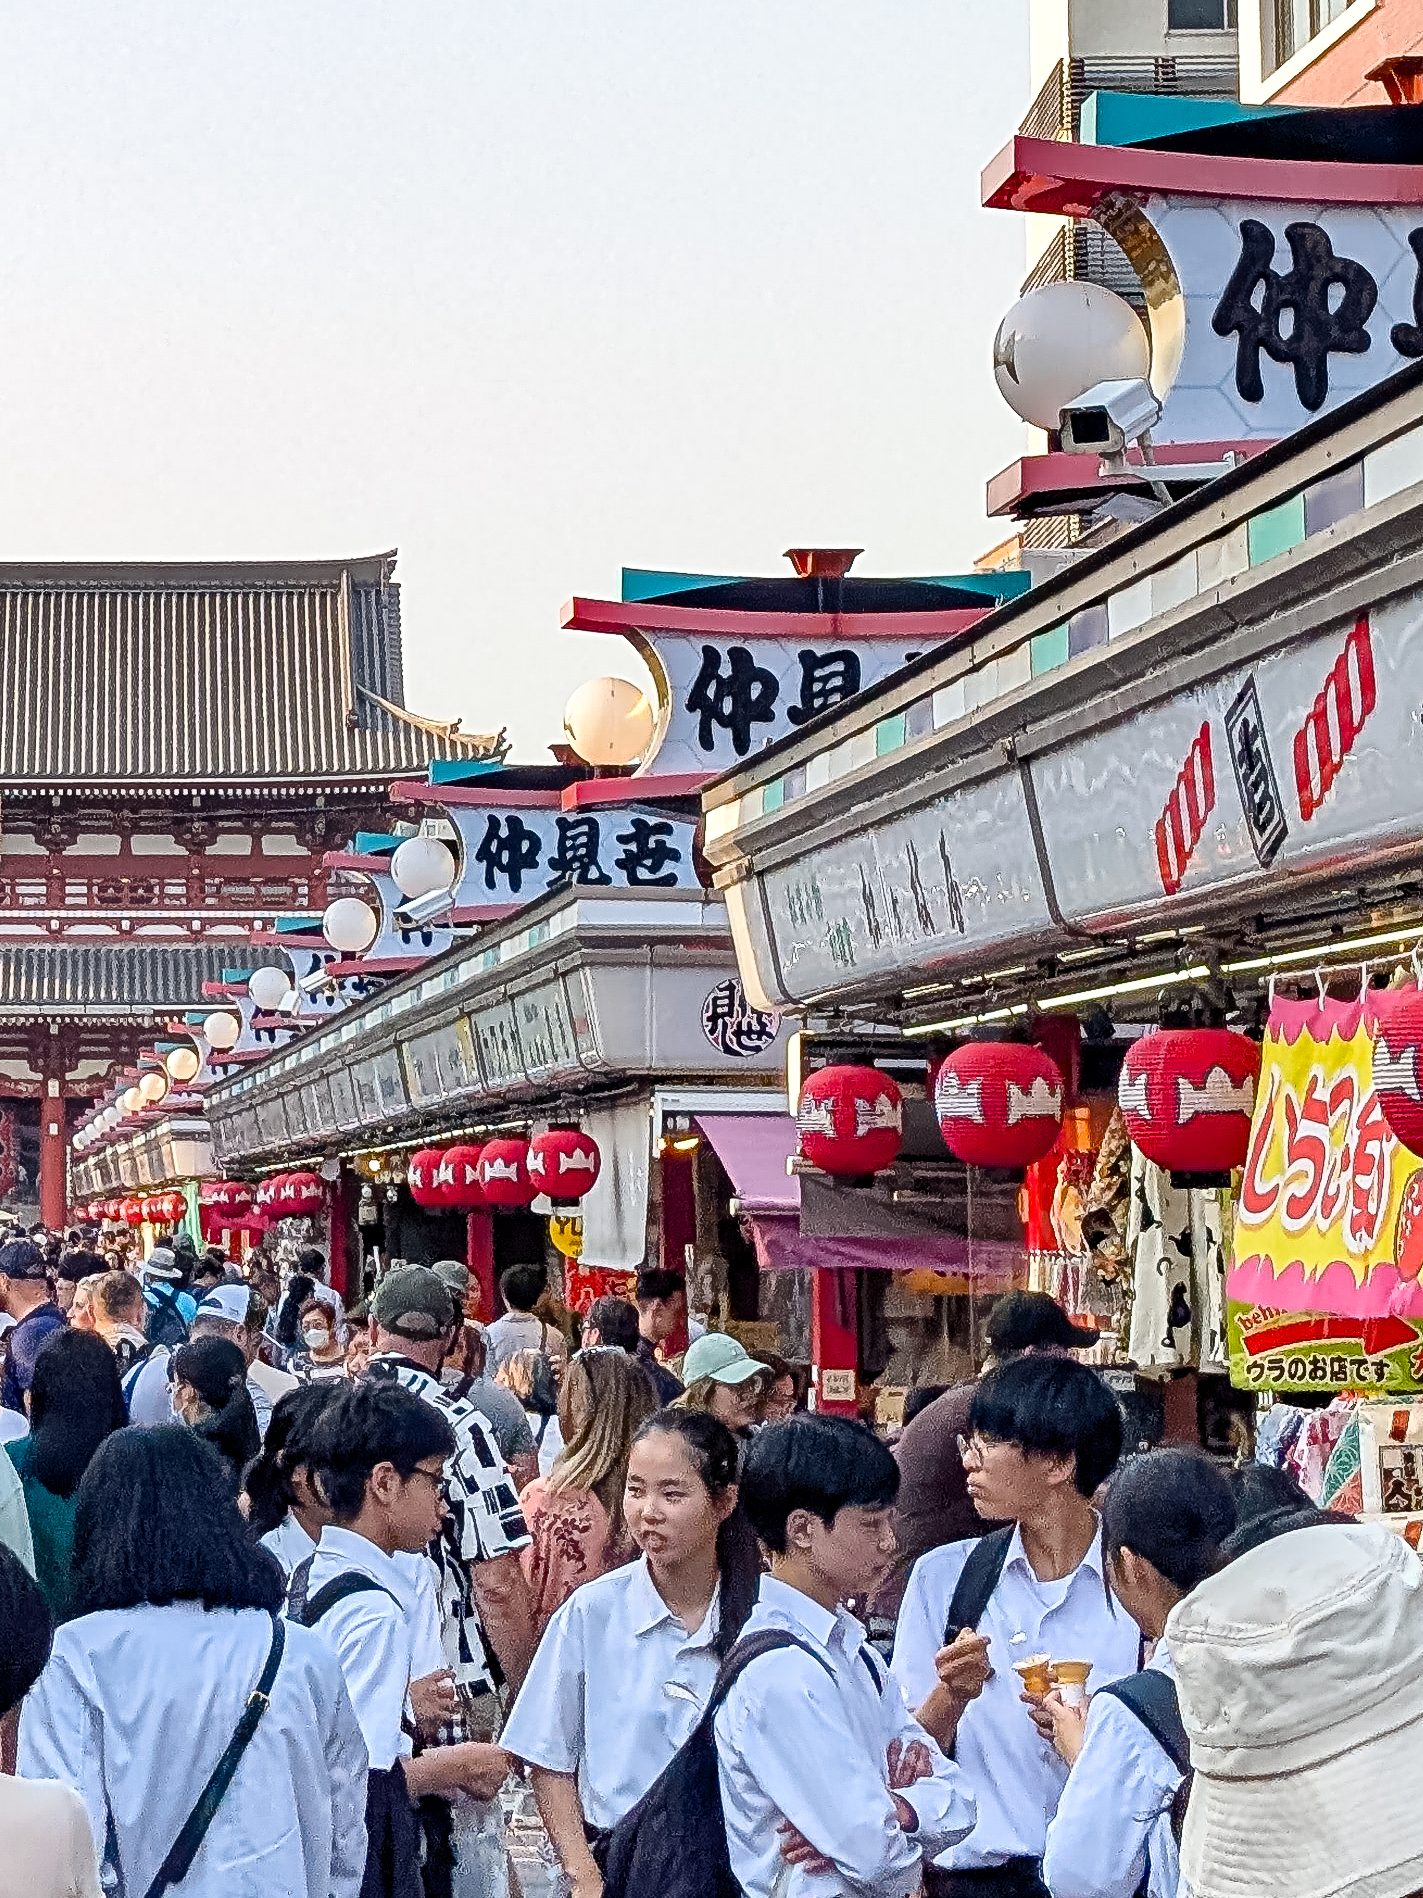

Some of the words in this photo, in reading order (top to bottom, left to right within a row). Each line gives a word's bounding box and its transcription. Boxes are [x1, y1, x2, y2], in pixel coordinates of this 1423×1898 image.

[475, 813, 682, 894] 仲見世
[1246, 1356, 1390, 1383] ウラのお店です
